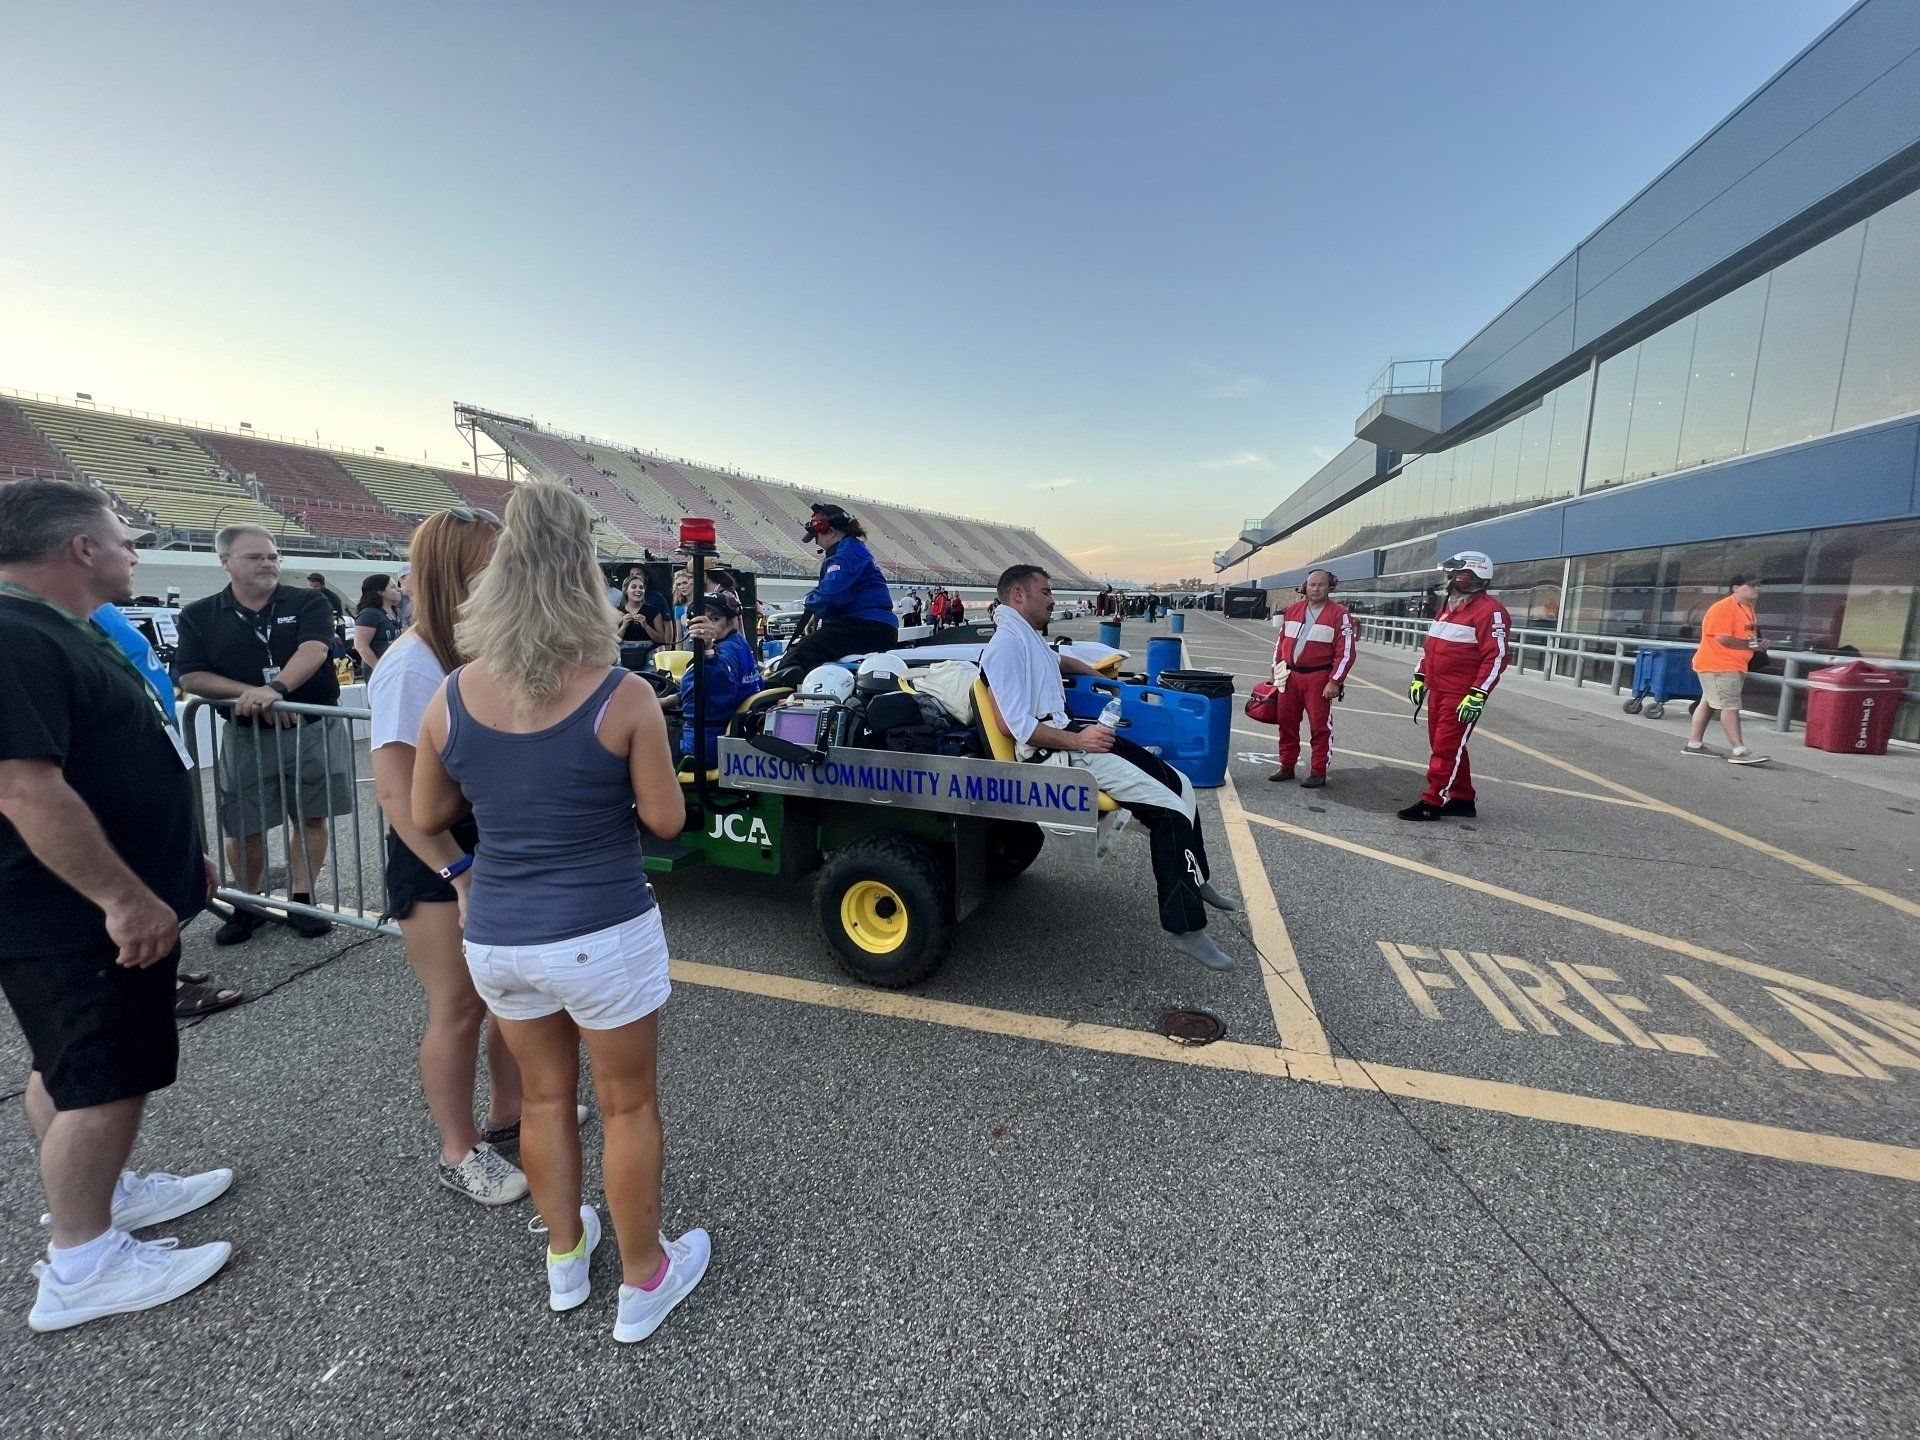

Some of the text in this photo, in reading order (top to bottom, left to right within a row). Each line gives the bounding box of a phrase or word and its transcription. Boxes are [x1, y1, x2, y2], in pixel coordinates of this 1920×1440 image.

[723, 752, 1091, 812] JACKSON COMMUNITY AMBULANCE
[708, 813, 773, 846] JCA
[1377, 940, 1720, 1059] FIRE
